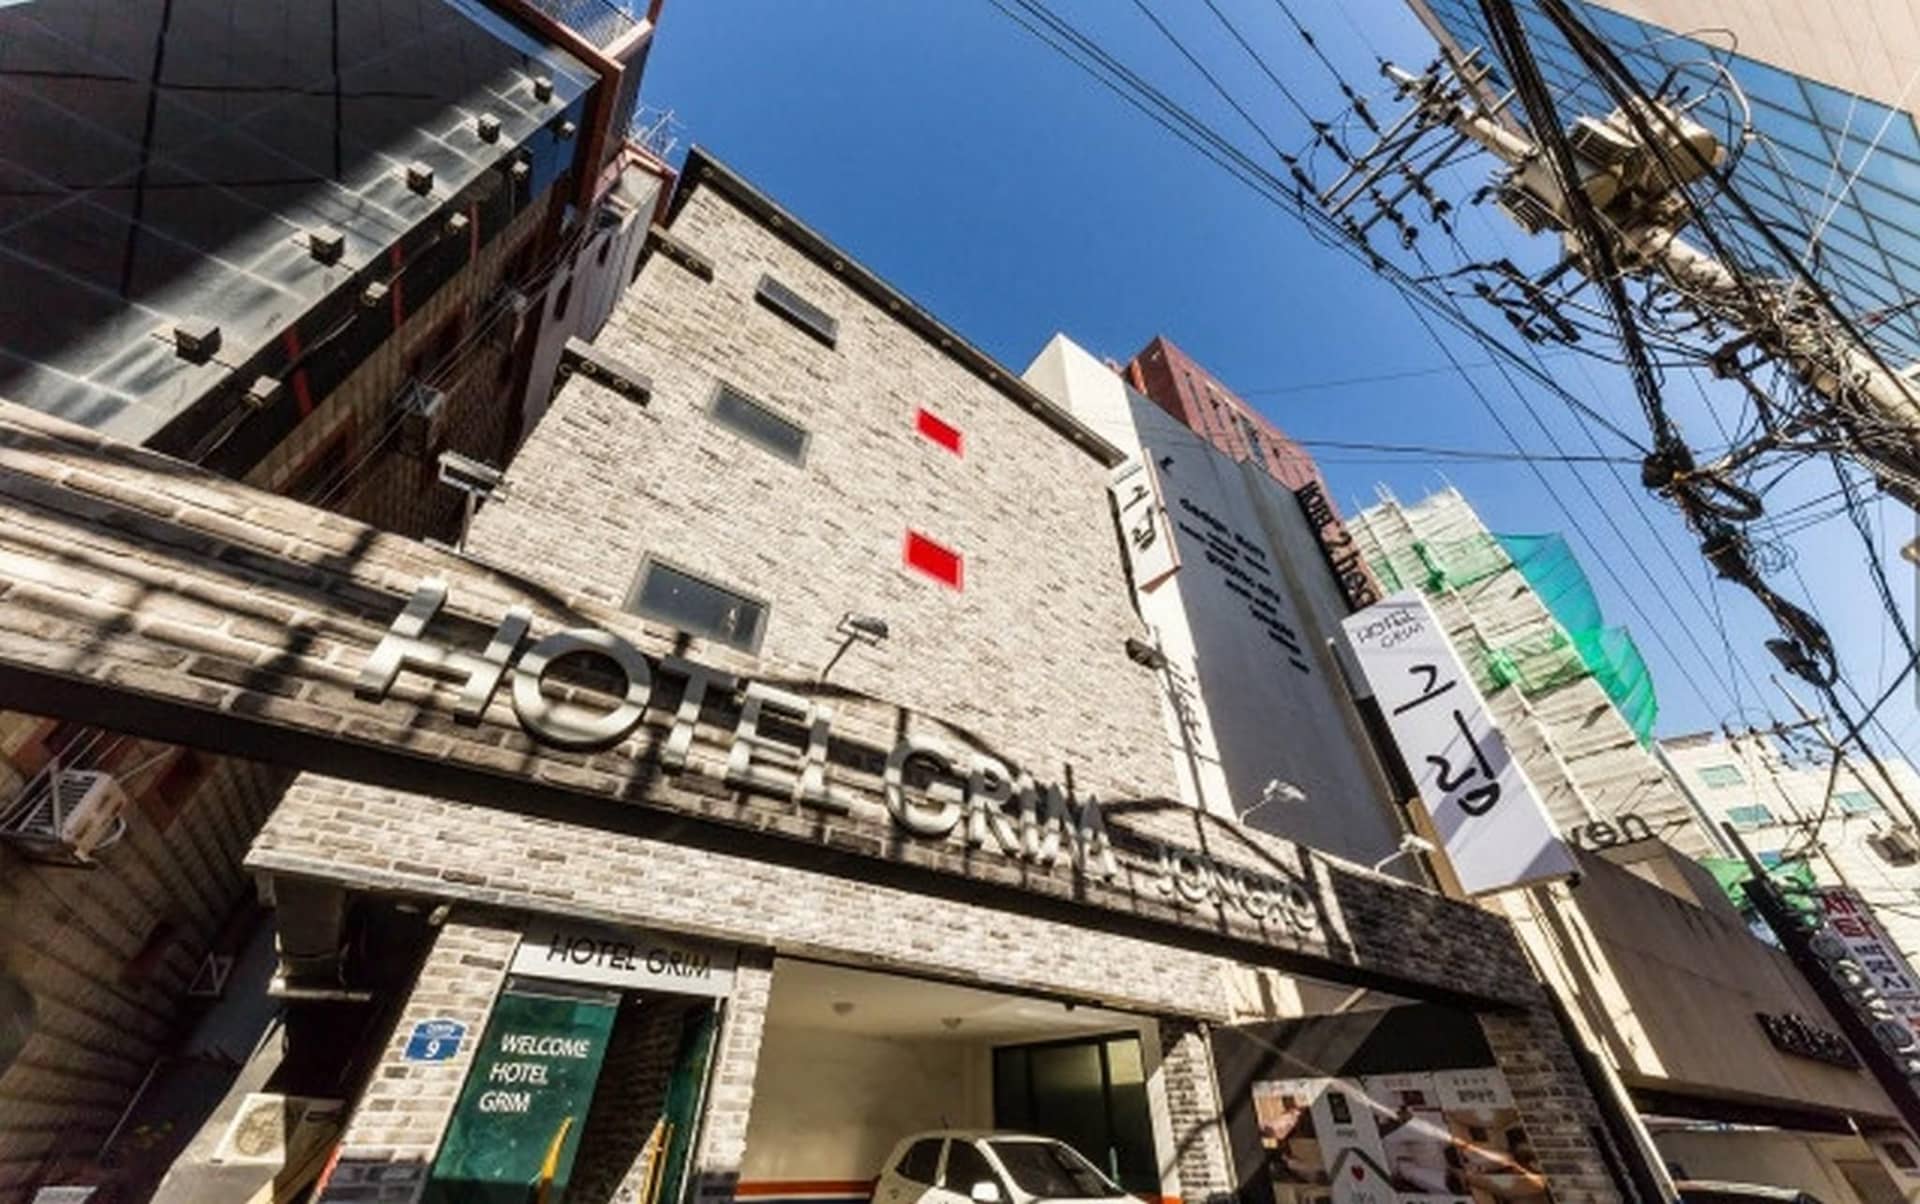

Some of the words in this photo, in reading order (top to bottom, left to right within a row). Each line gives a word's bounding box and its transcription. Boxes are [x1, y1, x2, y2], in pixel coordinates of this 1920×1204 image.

[1357, 609, 1416, 644] HOTEL
[1381, 622, 1425, 649] GRIM
[353, 576, 849, 816] HOTEL
[884, 734, 1118, 882] GRIM
[1393, 664, 1500, 817] 그림
[546, 933, 638, 972] HOTEL
[645, 948, 712, 980] GRIM
[424, 1039, 440, 1059] 9
[500, 1033, 591, 1059] WELCOME
[488, 1062, 550, 1086] HOTEL
[478, 1090, 531, 1114] GRIM
